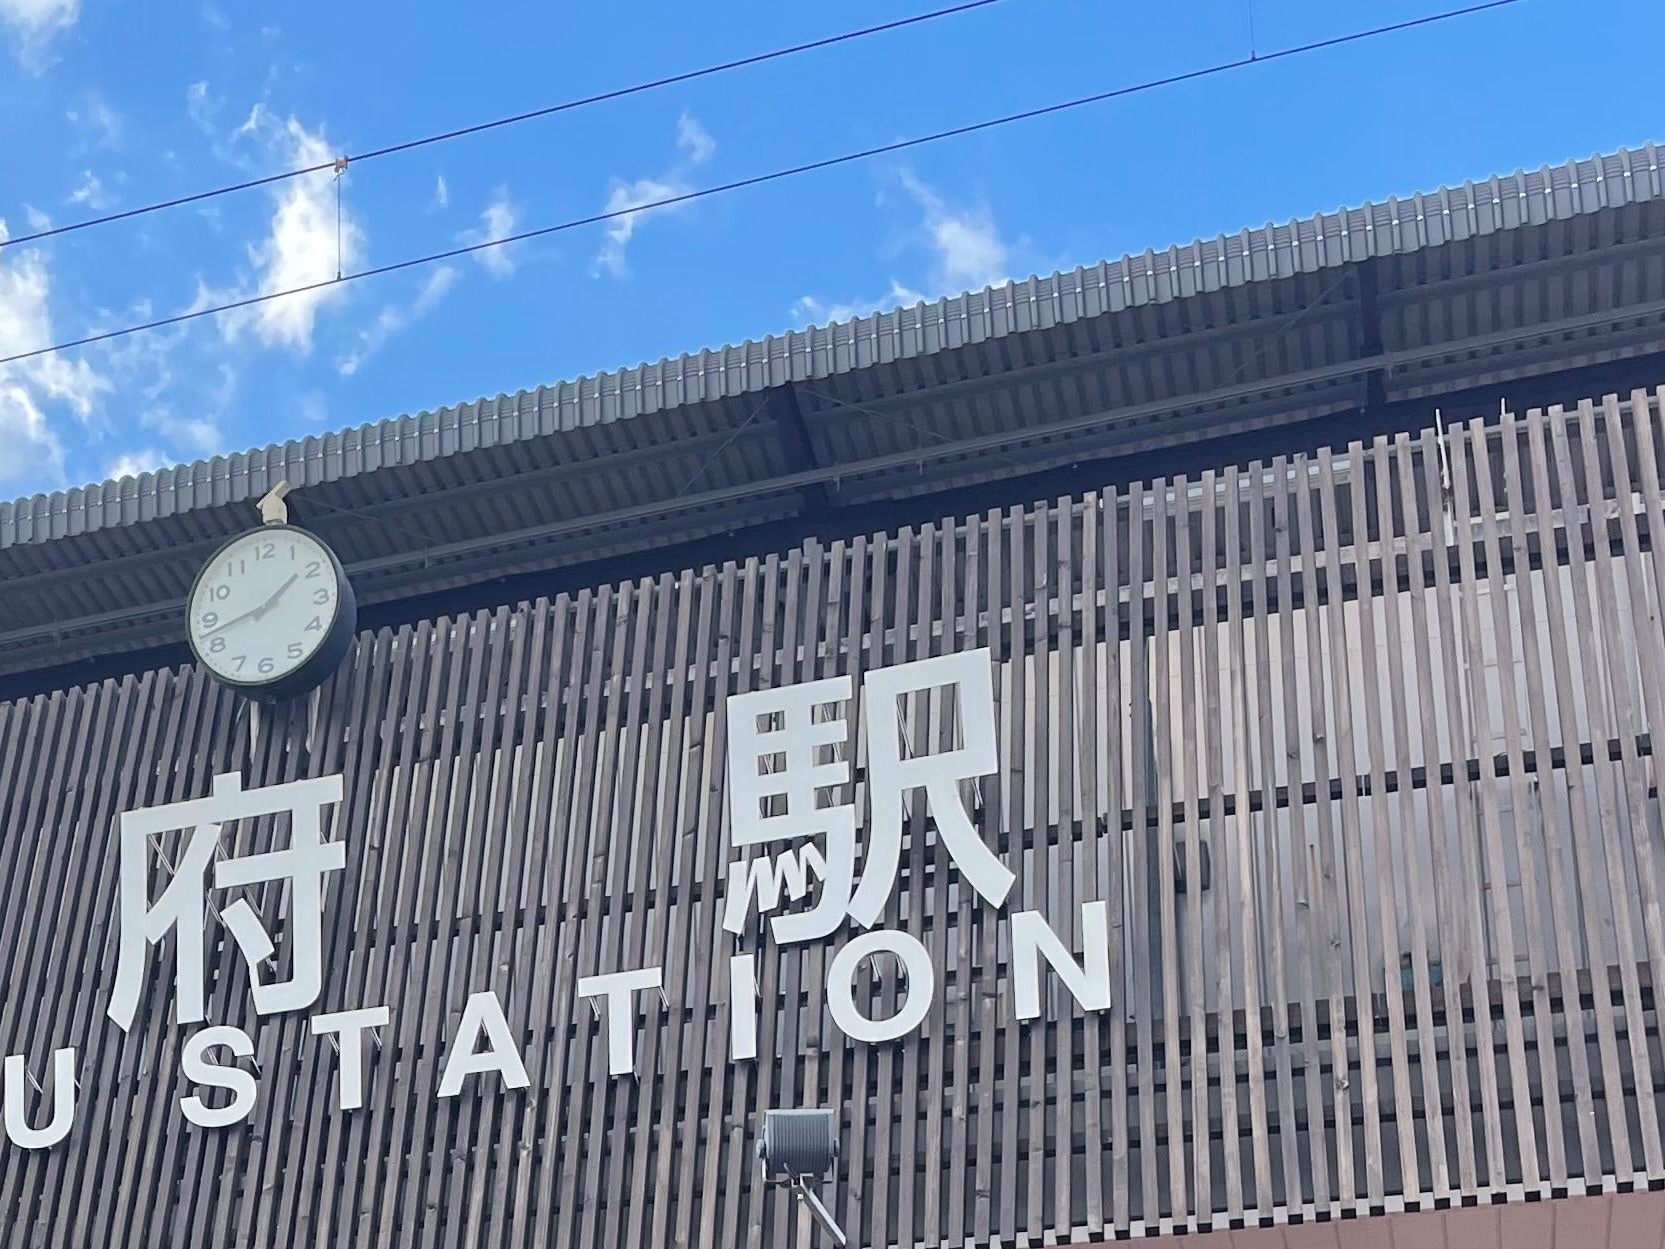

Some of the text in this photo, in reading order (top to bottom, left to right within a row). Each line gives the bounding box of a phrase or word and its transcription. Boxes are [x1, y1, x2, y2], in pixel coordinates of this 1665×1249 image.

[255, 543, 276, 561] 12
[289, 544, 297, 560] 1
[227, 560, 245, 577] 11
[305, 561, 321, 579] 2
[208, 584, 231, 603] 10
[313, 588, 330, 606] 3
[201, 611, 219, 628] 9
[304, 615, 323, 632] 4
[210, 637, 226, 653] 8
[287, 642, 303, 659] 5
[231, 655, 247, 672] 7
[257, 657, 275, 674] 6
[180, 901, 1112, 1129] STATION
